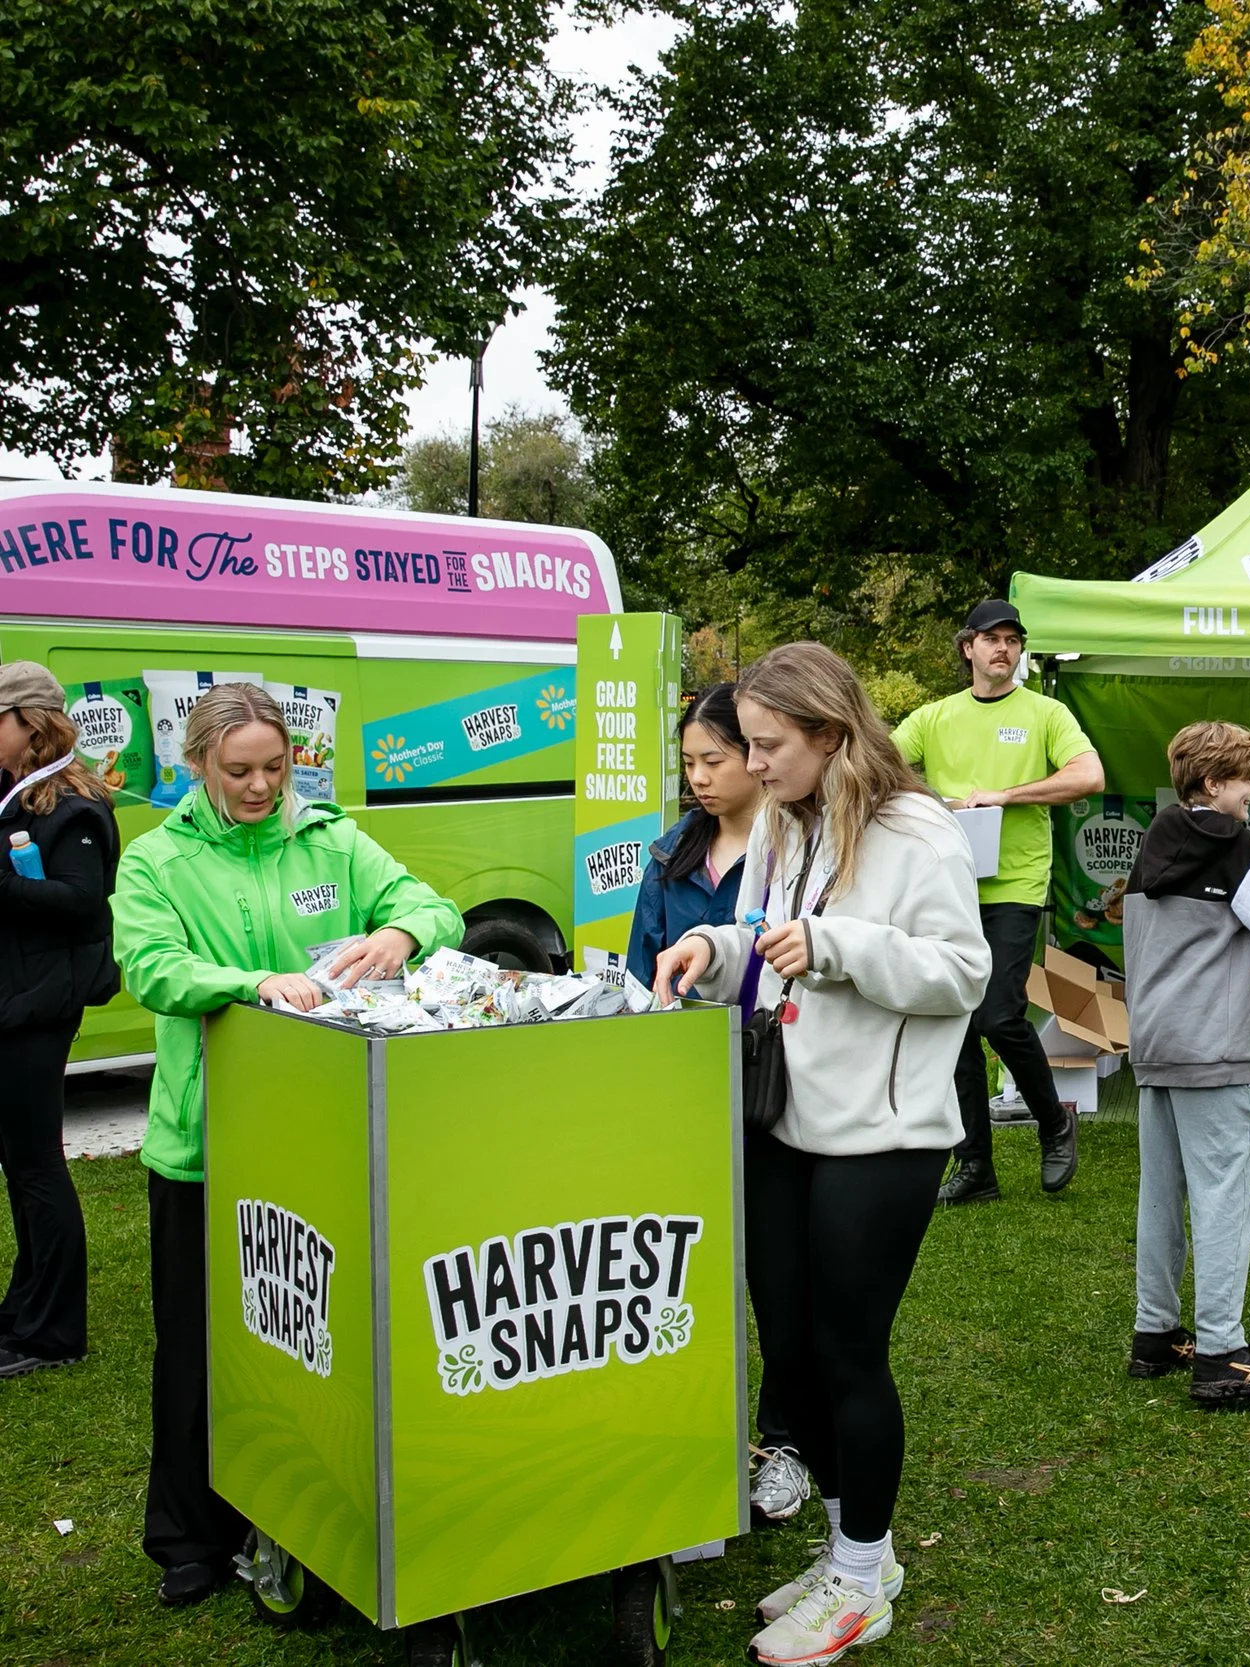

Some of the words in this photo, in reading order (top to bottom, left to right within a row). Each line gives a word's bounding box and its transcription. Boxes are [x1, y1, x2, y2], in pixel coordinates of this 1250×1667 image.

[0, 519, 93, 573] HERE
[109, 518, 178, 570] FOR
[186, 532, 258, 581] The
[264, 543, 348, 581] STEPS
[355, 549, 440, 584] STAYED
[446, 556, 466, 571] FOR
[448, 572, 468, 587] THE
[471, 552, 591, 599] SNACKS
[1183, 606, 1244, 636] FULL
[596, 680, 637, 708] GRAB
[72, 707, 123, 727] HARVEST
[286, 716, 314, 730] SNAPS
[464, 706, 517, 738] HARVEST
[595, 712, 636, 739] YOUR
[85, 722, 117, 737] SNAPS
[479, 727, 513, 747] SNAPS
[80, 735, 125, 749] SCOOPERS
[389, 745, 427, 763] Mother's
[427, 741, 444, 753] Day
[413, 751, 444, 768] Classic
[596, 743, 635, 770] FREE
[585, 773, 647, 803] SNACKS
[1083, 828, 1145, 849] HARVEST
[587, 843, 641, 880] HARVEST
[1095, 845, 1133, 859] SNAPS
[1086, 860, 1133, 871] SCOOPER
[600, 867, 634, 891] SNAPS
[292, 884, 338, 906] HARVEST
[306, 898, 332, 914] SNAPS
[238, 1203, 334, 1321] HARVEST
[432, 1219, 699, 1340] HARVEST
[257, 1277, 315, 1364] SNAPS
[490, 1294, 652, 1381] SNAPS
